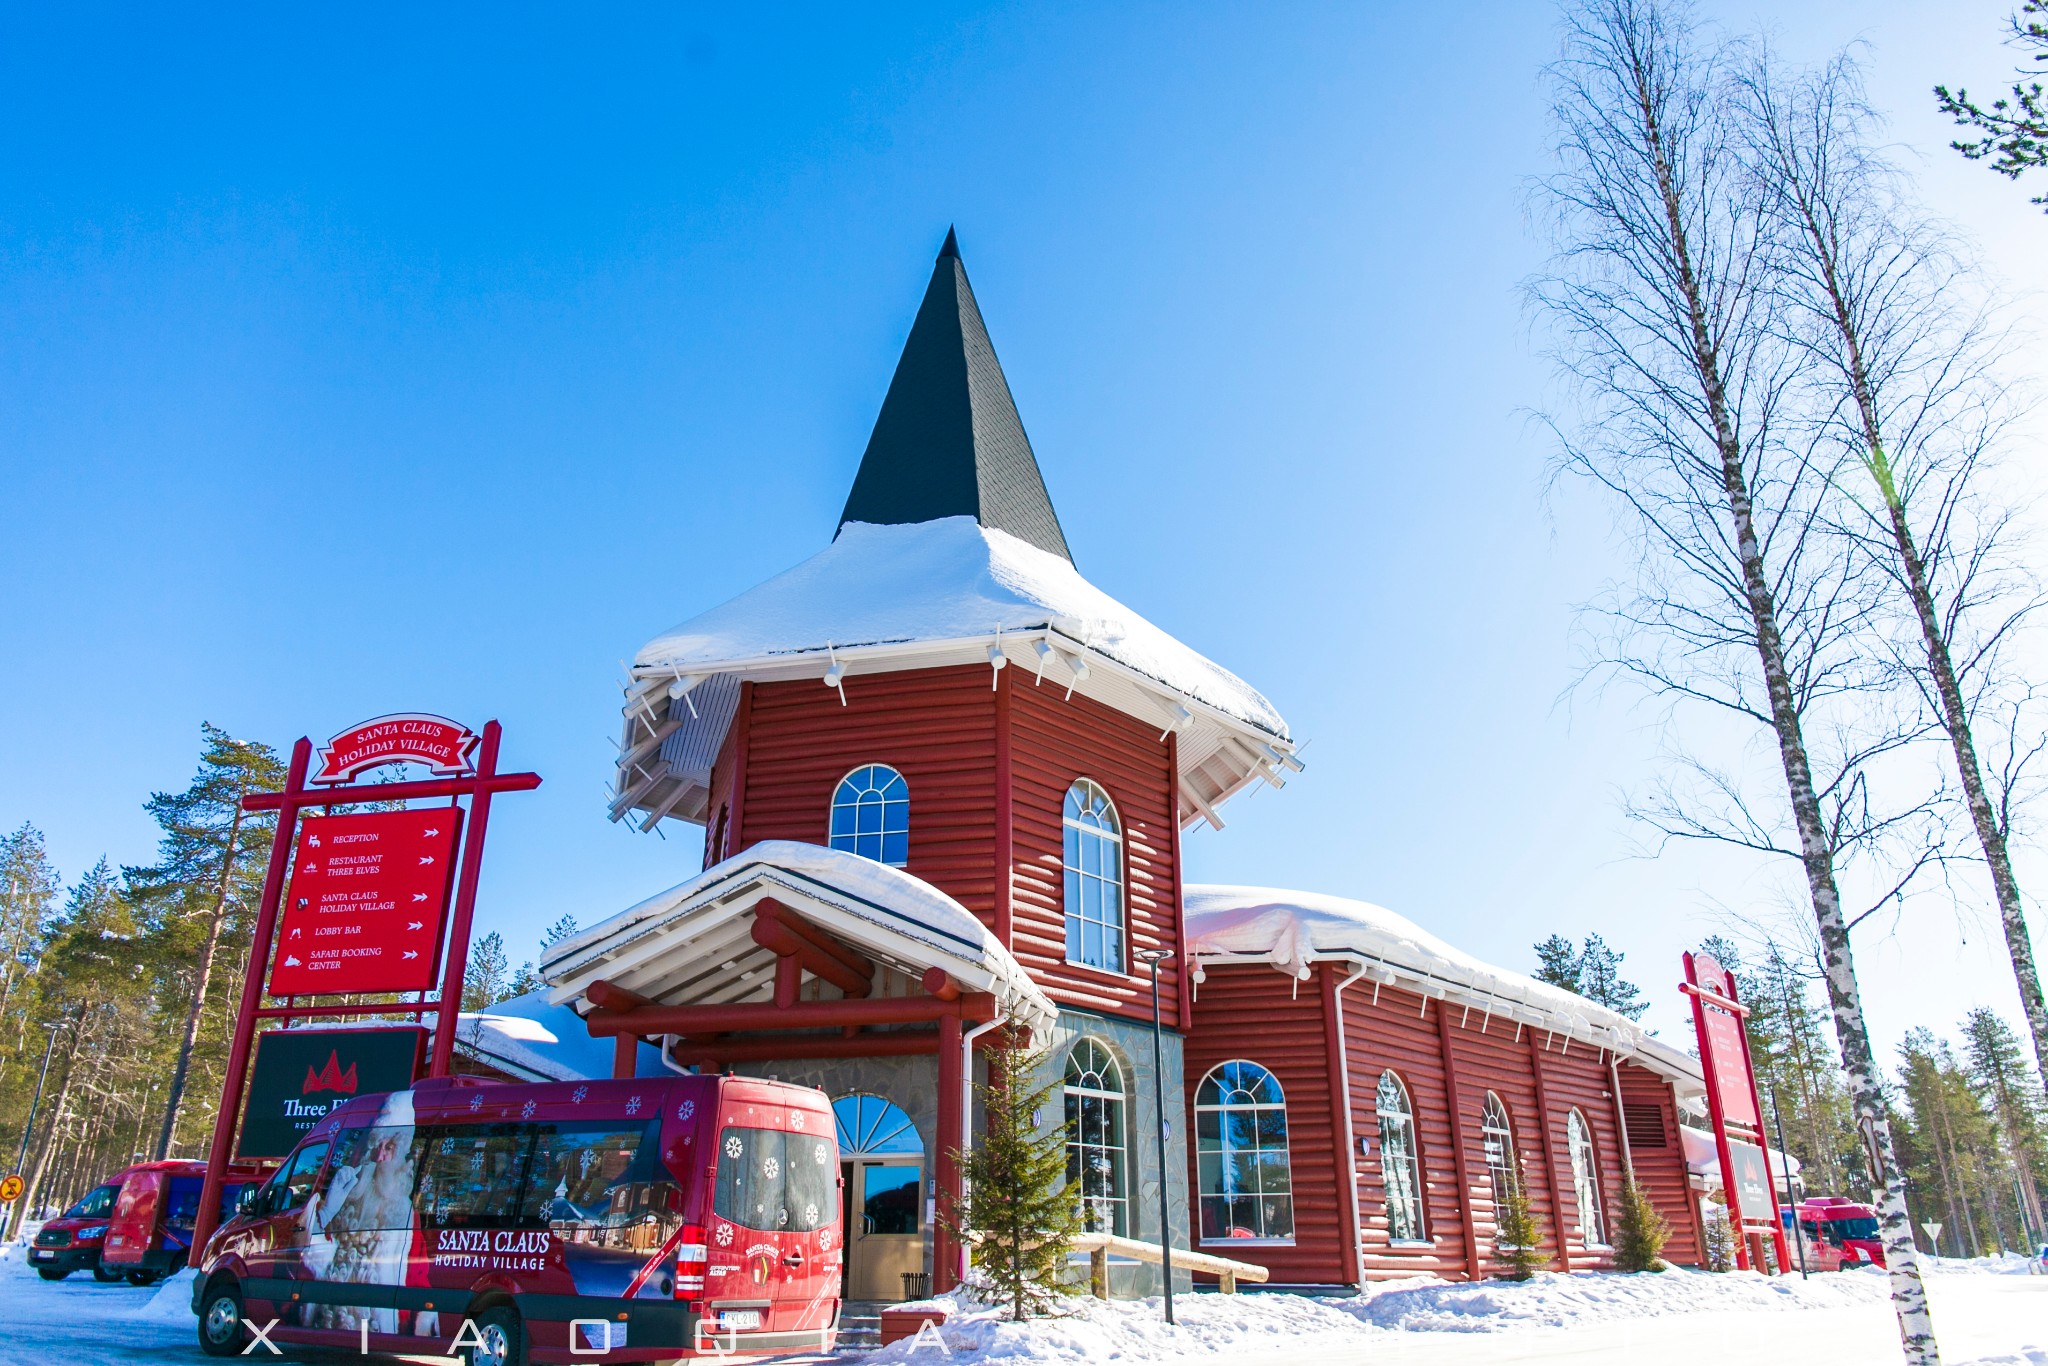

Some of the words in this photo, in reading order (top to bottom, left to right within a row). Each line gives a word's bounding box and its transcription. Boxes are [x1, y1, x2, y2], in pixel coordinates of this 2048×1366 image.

[357, 724, 398, 743] SANTA
[403, 723, 442, 737] CLAUS
[339, 740, 396, 766] HOLIDAY
[400, 740, 450, 758] VILLAGE
[333, 833, 379, 844] RECEPTION
[329, 854, 383, 866] RESTAURANT
[327, 867, 354, 877] THREE
[355, 866, 380, 875] ELVES
[321, 893, 348, 902] SANTA
[350, 891, 378, 901] CLAUS
[320, 903, 357, 914] HOLIDAY
[359, 901, 396, 911] VILLAGE
[315, 926, 343, 936] LOBBY
[344, 925, 362, 935] BAR
[310, 949, 340, 959] SAFARI
[341, 947, 382, 957] BOOKING
[308, 961, 341, 971] CENTER
[284, 1099, 327, 1116] Three
[438, 1230, 490, 1251] SANTA
[494, 1231, 549, 1254] CLAUS
[435, 1255, 487, 1268] HOLIDAY
[493, 1256, 545, 1270] VILLAGE
